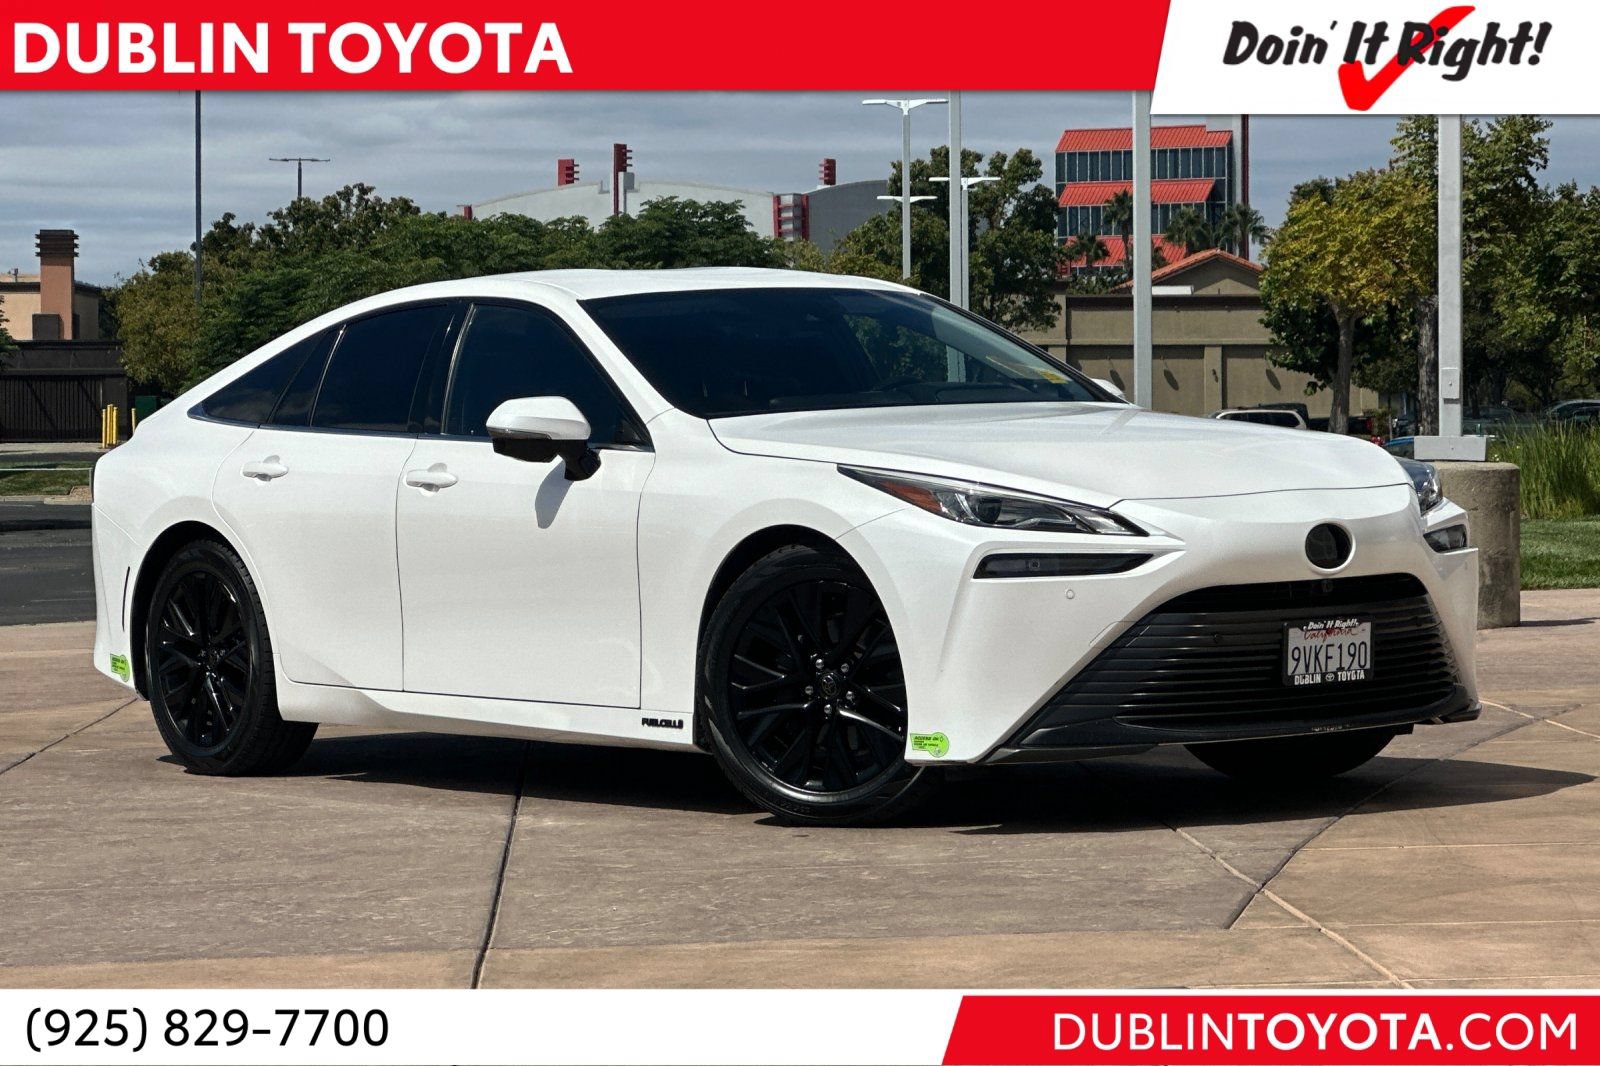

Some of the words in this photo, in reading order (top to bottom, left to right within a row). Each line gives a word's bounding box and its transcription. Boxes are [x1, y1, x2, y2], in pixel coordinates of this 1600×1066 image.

[1291, 641, 1367, 674] 9VKF190
[1294, 673, 1322, 685] DUBLIN
[1337, 670, 1365, 682] TOYOTA
